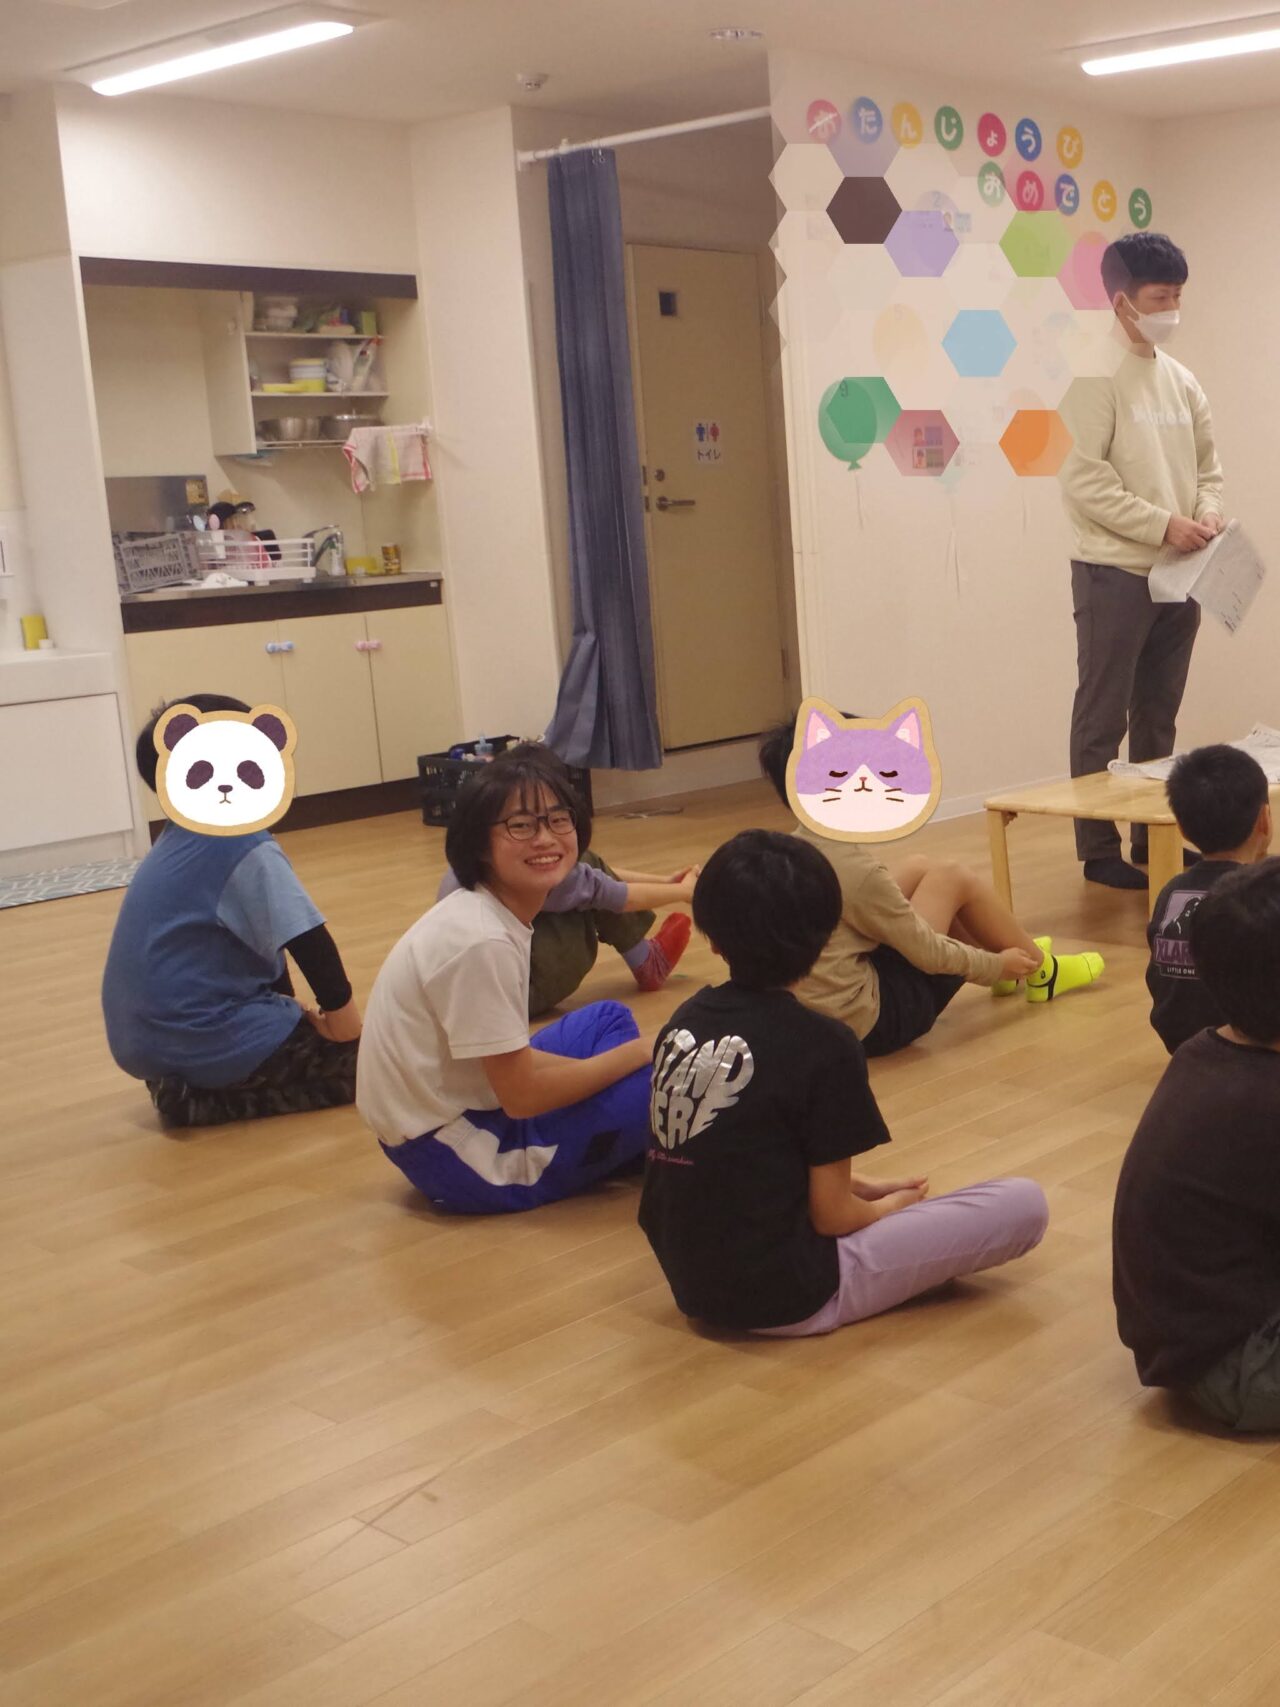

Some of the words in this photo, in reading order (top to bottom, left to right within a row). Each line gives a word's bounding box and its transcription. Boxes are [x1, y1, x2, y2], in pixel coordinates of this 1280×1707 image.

[983, 171, 1147, 221] おめでとう
[697, 449, 721, 461] トイレ
